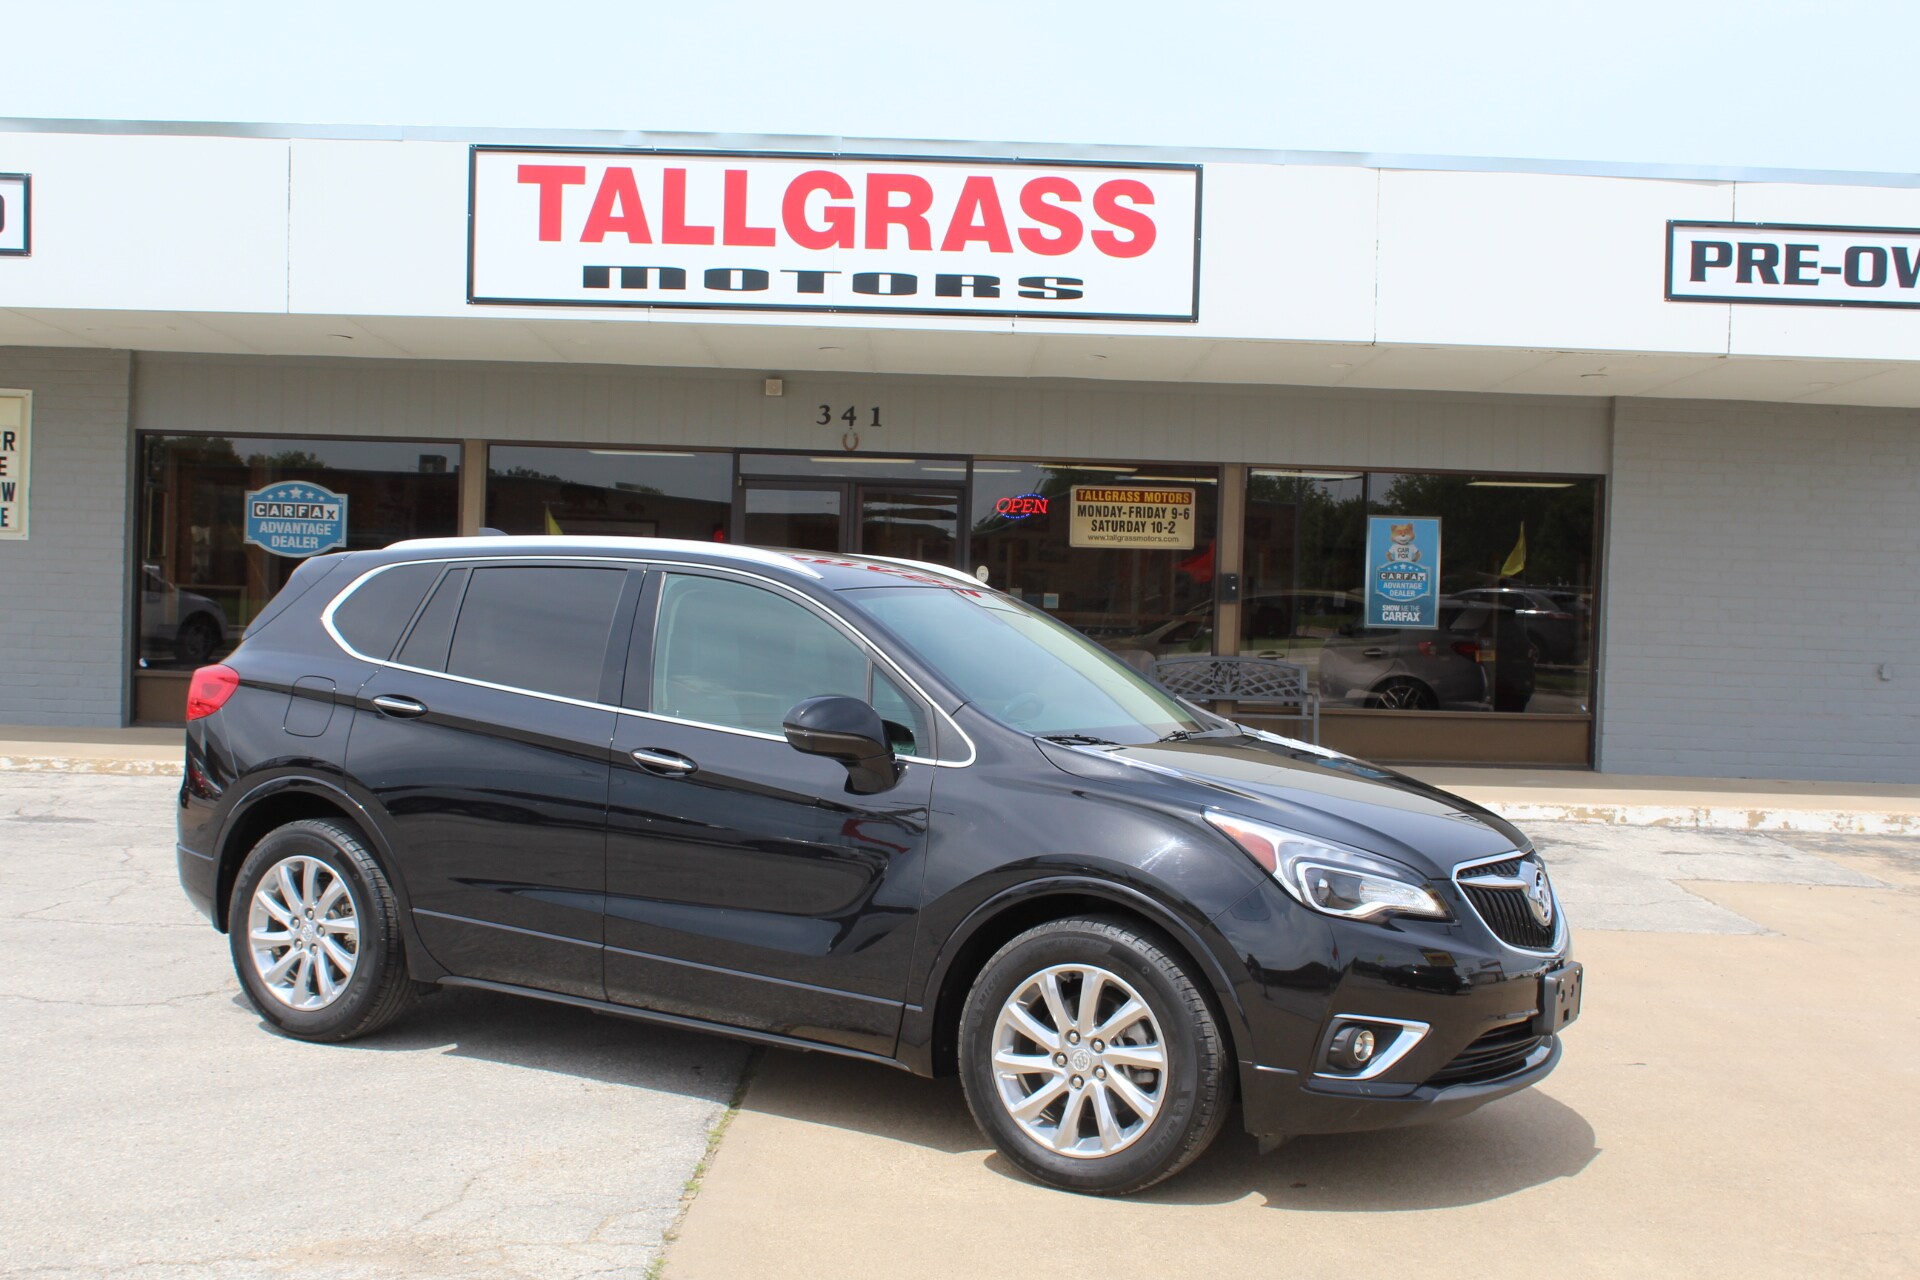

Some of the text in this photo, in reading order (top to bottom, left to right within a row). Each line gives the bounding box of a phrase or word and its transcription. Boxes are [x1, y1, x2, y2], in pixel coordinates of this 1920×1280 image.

[518, 164, 1157, 259] TALLGRASS
[815, 404, 882, 428] 341
[1079, 490, 1190, 504] TALLGRASS MOTORS
[254, 504, 336, 519] CARFAX
[996, 497, 1048, 514] OPEN
[1077, 504, 1190, 521] MONDAY-FRIDAY 9-6
[1091, 519, 1176, 534] SATURDAY 10-2
[271, 535, 319, 549] DEALER
[1087, 534, 1179, 543] www.tallgrassmotors.com
[1380, 572, 1426, 581] CARFAX
[1389, 589, 1416, 597] DEALER
[1382, 611, 1420, 622] CARFAX
